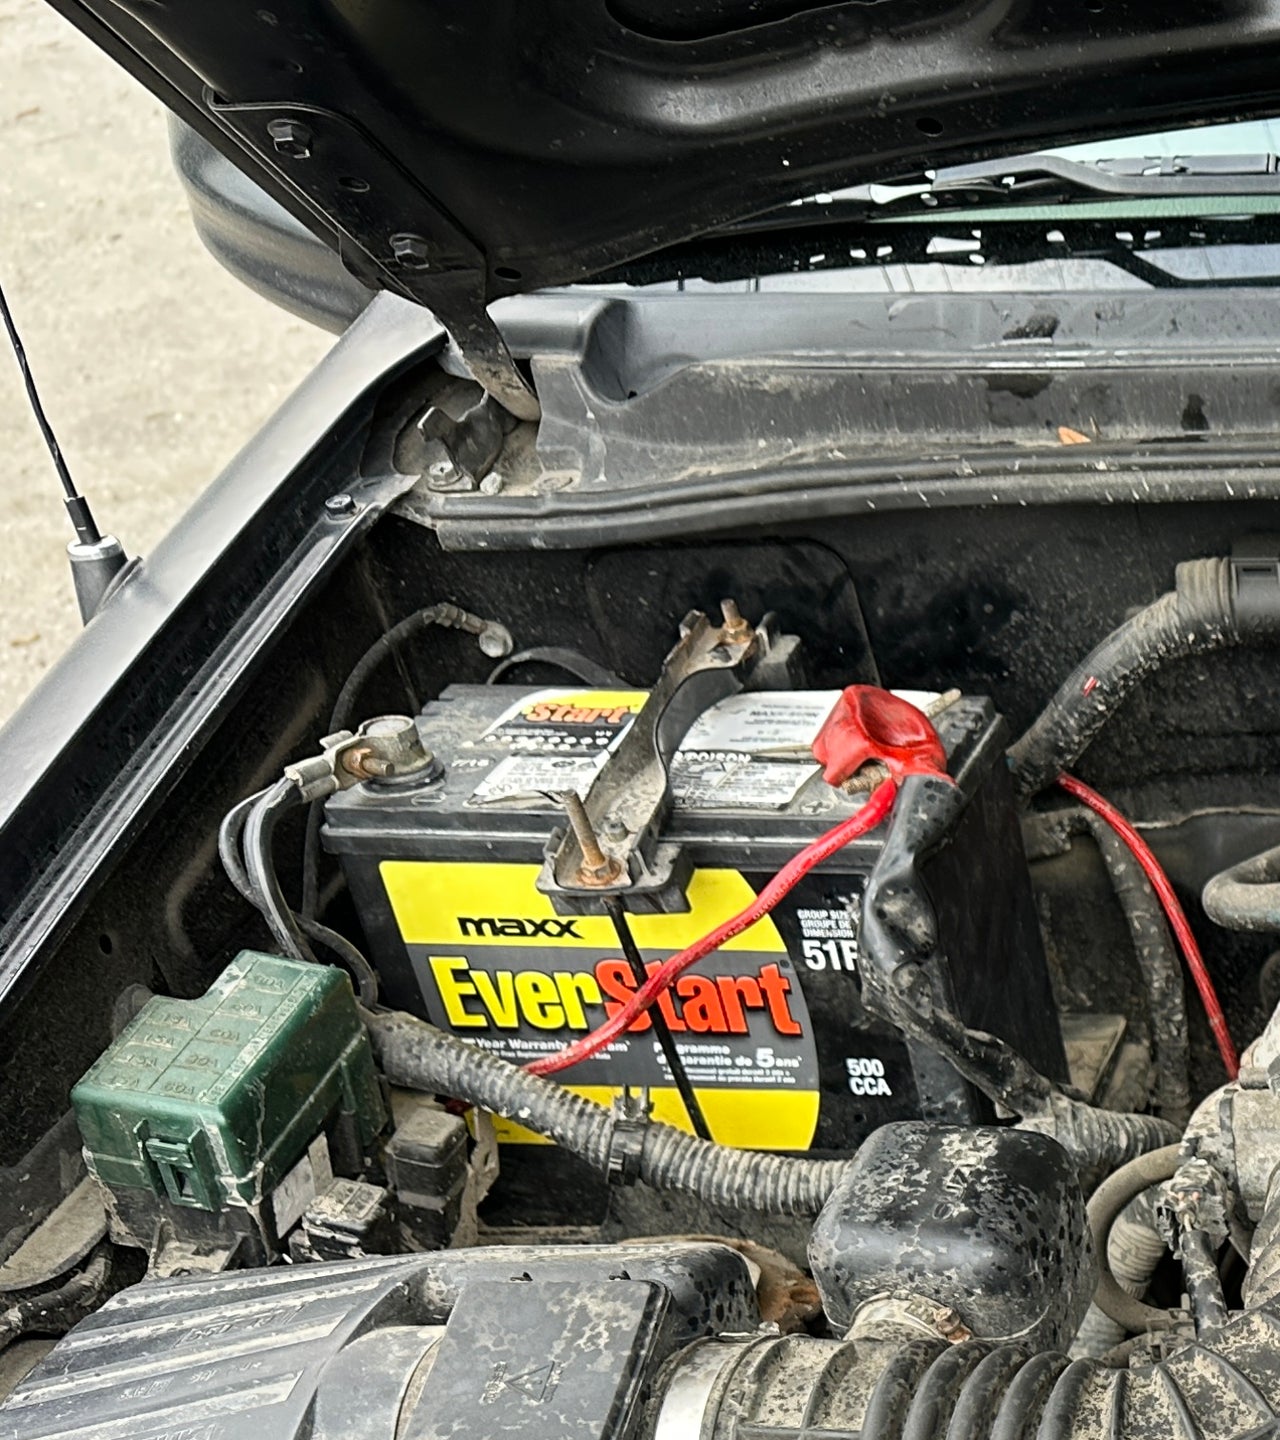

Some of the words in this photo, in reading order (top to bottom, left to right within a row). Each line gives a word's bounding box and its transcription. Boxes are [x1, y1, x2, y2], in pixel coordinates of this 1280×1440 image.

[520, 703, 630, 723] Start
[456, 917, 585, 939] maxx
[476, 1038, 506, 1049] Year
[508, 1038, 568, 1052] Warranty
[755, 1047, 775, 1068] 5
[845, 1057, 885, 1077] 500
[848, 1077, 893, 1096] CCA
